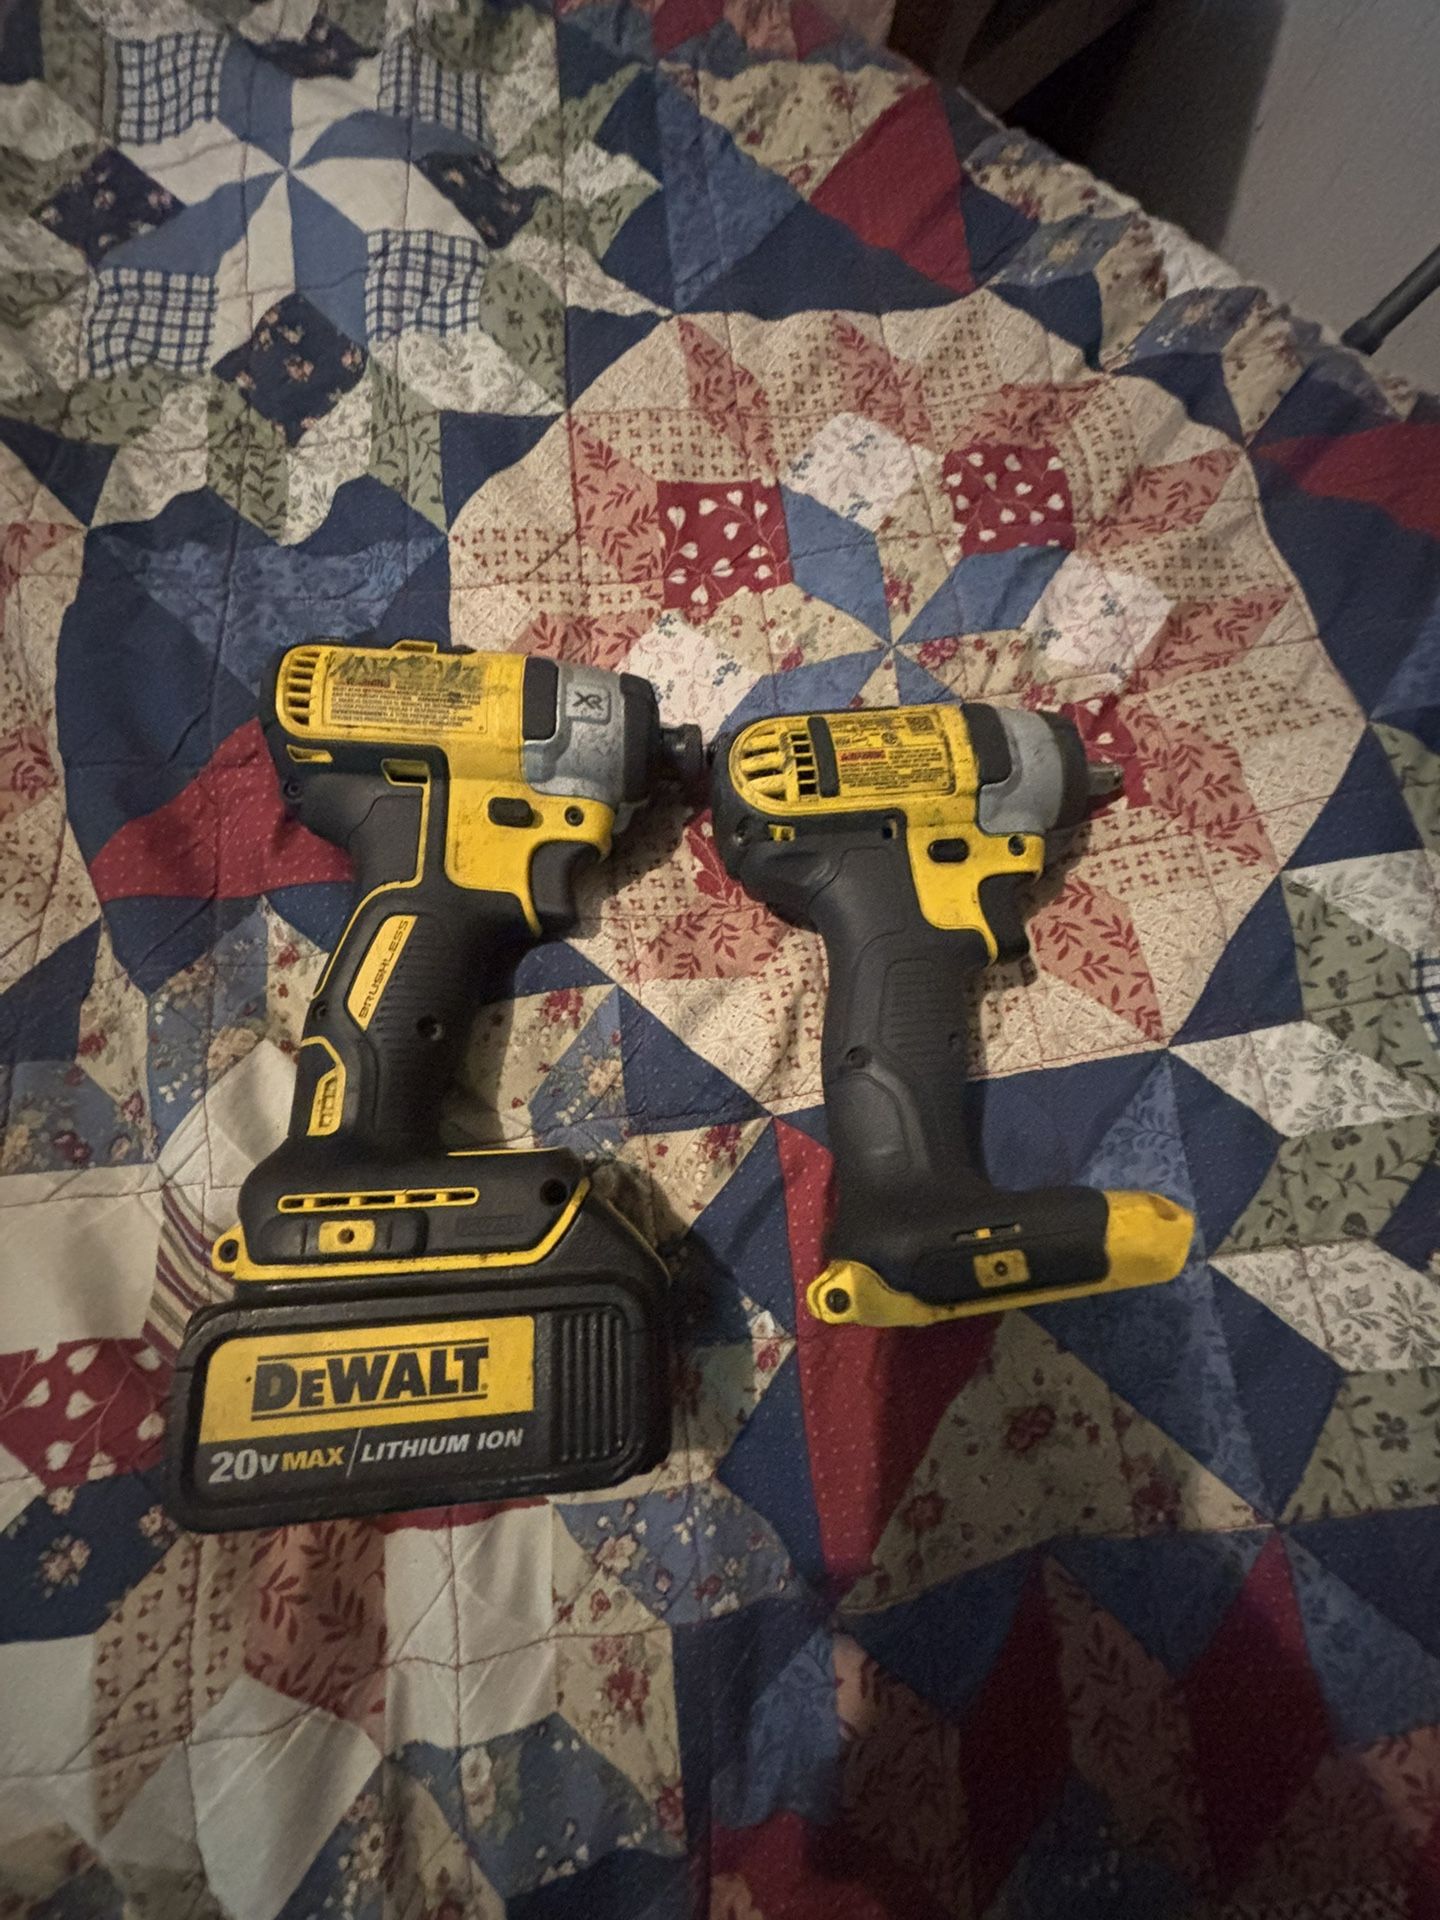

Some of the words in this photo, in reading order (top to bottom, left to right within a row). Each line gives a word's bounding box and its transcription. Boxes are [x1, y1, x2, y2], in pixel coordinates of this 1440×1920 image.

[572, 691, 604, 711] XR
[358, 919, 409, 1019] BRUSHLESS
[281, 1445, 345, 1473] MAX
[360, 1432, 469, 1463] LITHIUM
[477, 1428, 524, 1450] ION
